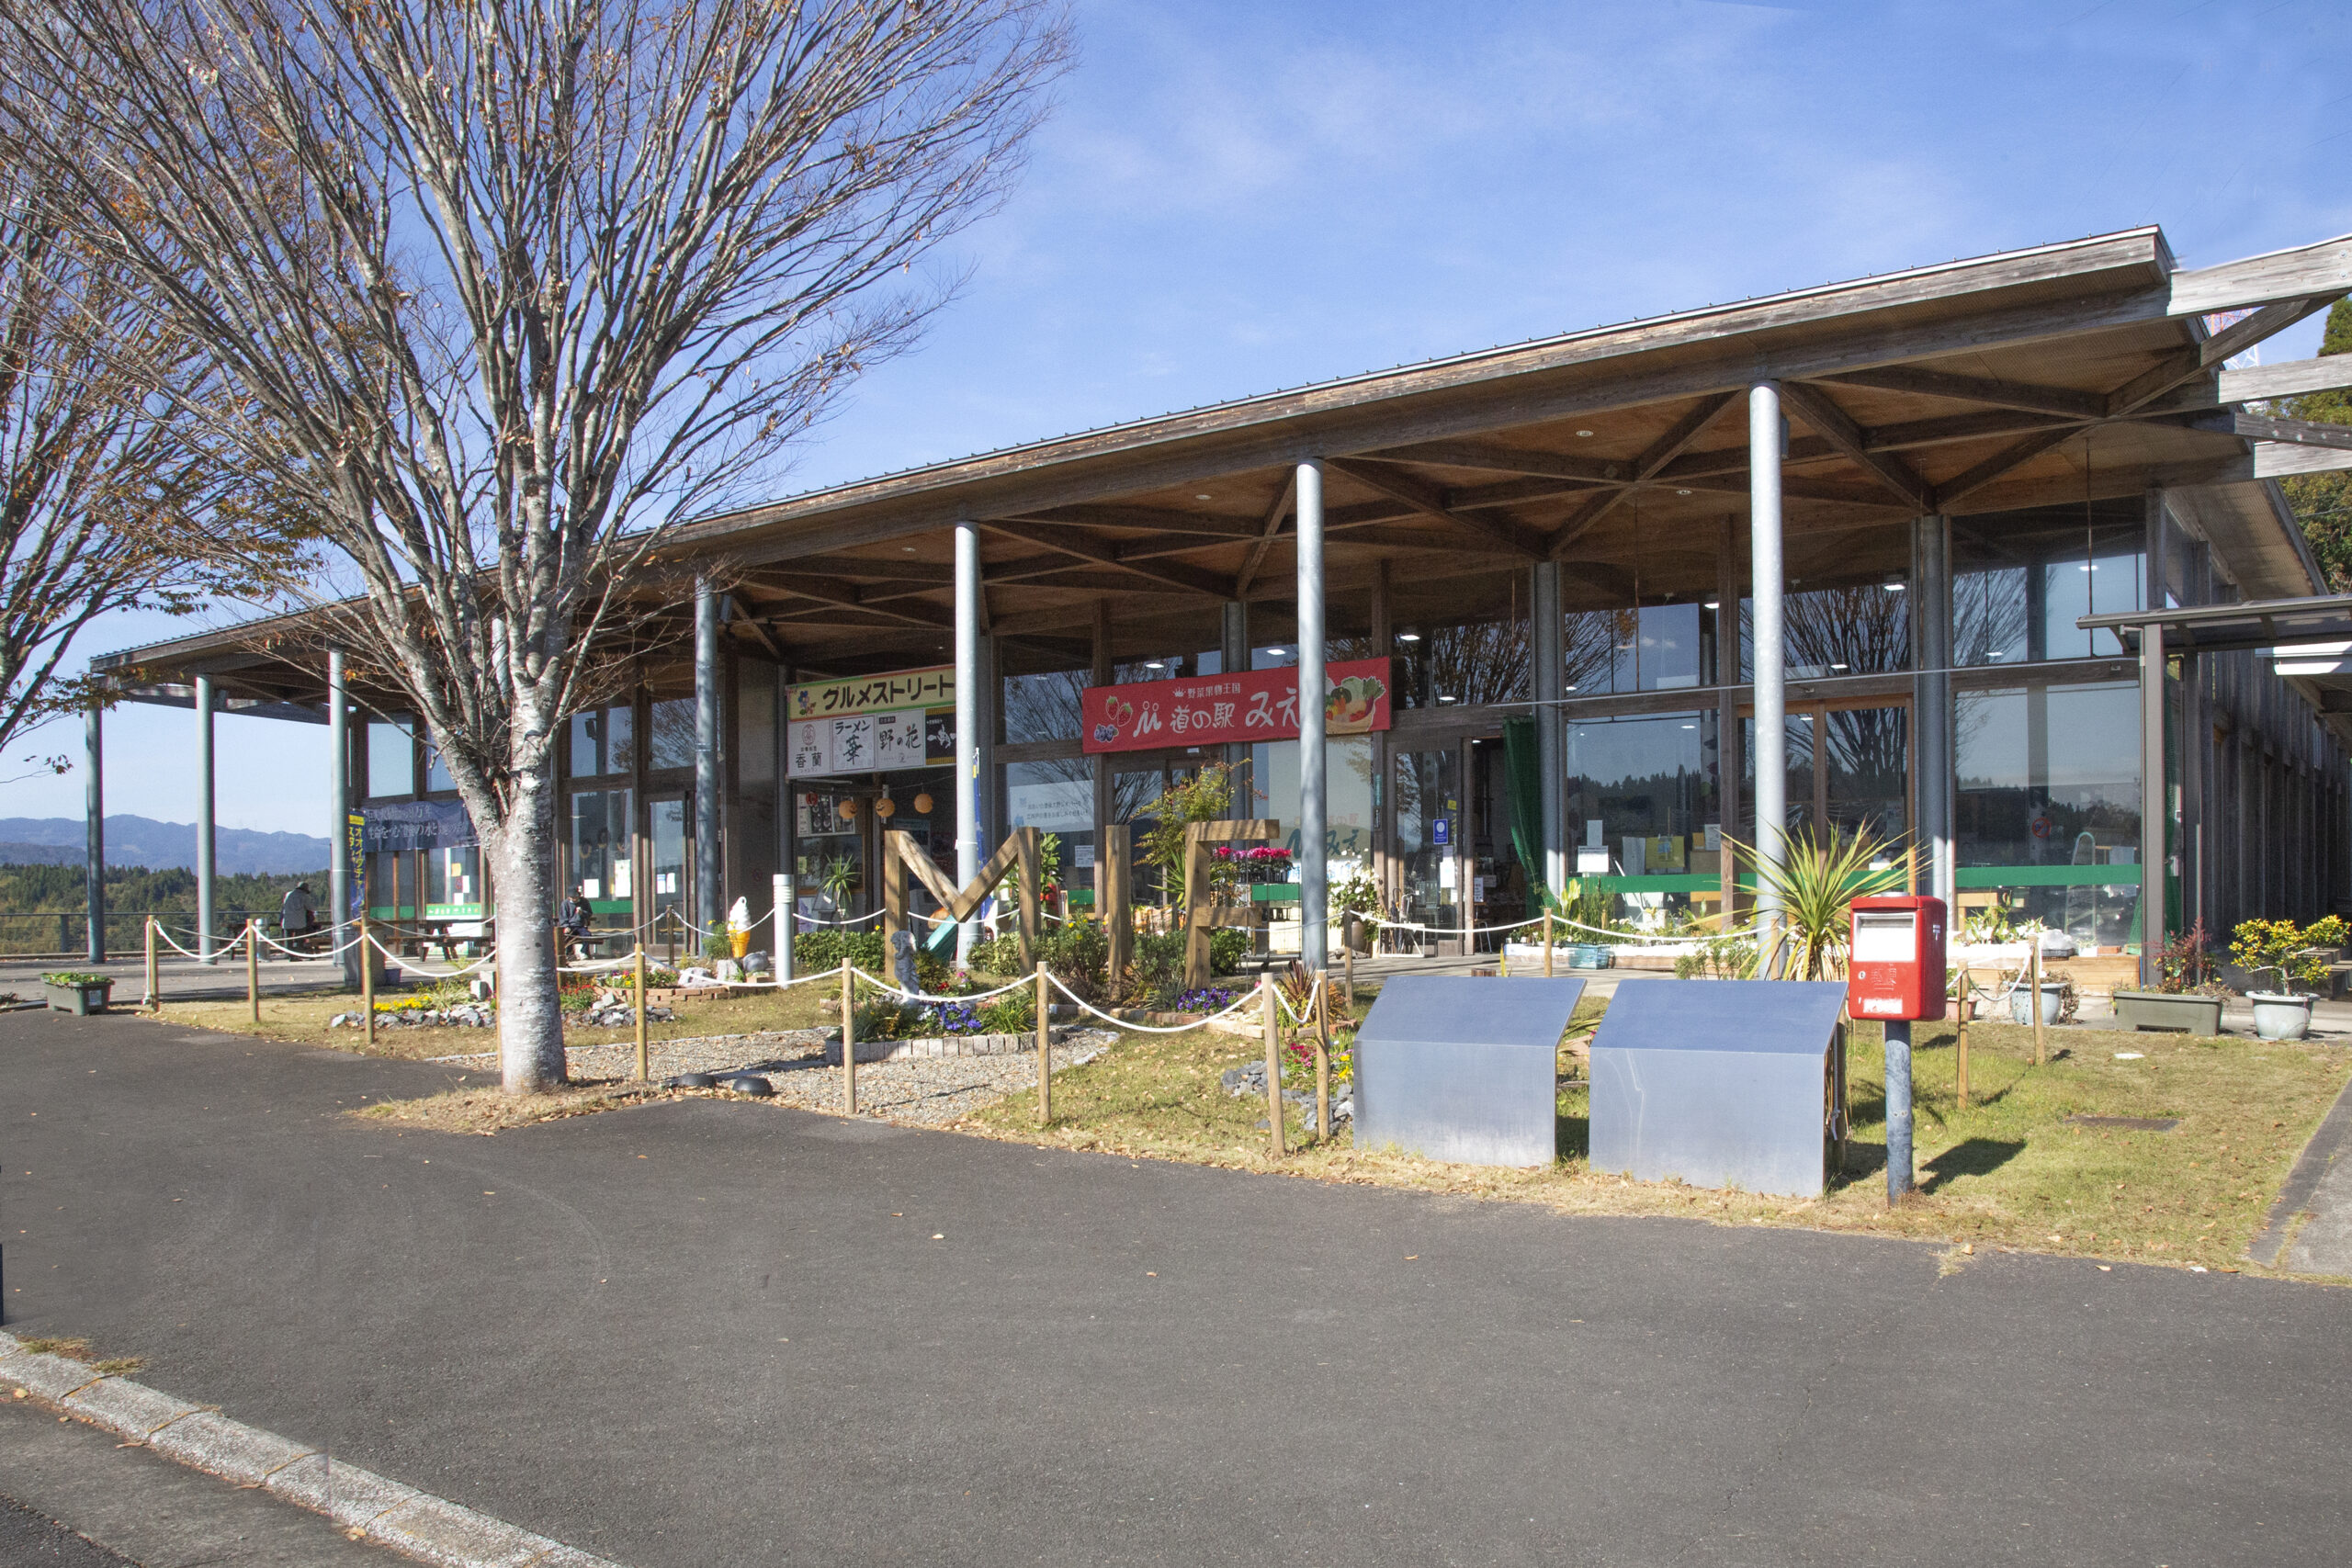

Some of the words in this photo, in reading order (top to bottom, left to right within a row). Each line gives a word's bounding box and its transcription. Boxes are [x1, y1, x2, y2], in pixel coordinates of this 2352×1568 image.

[823, 674, 955, 710] グルメストリート
[1187, 682, 1240, 699] 野菜果物王国
[835, 720, 870, 735] ラーメン
[1170, 703, 1235, 733] 道の駅
[879, 723, 922, 751] 野の花
[795, 752, 823, 769] 香蘭
